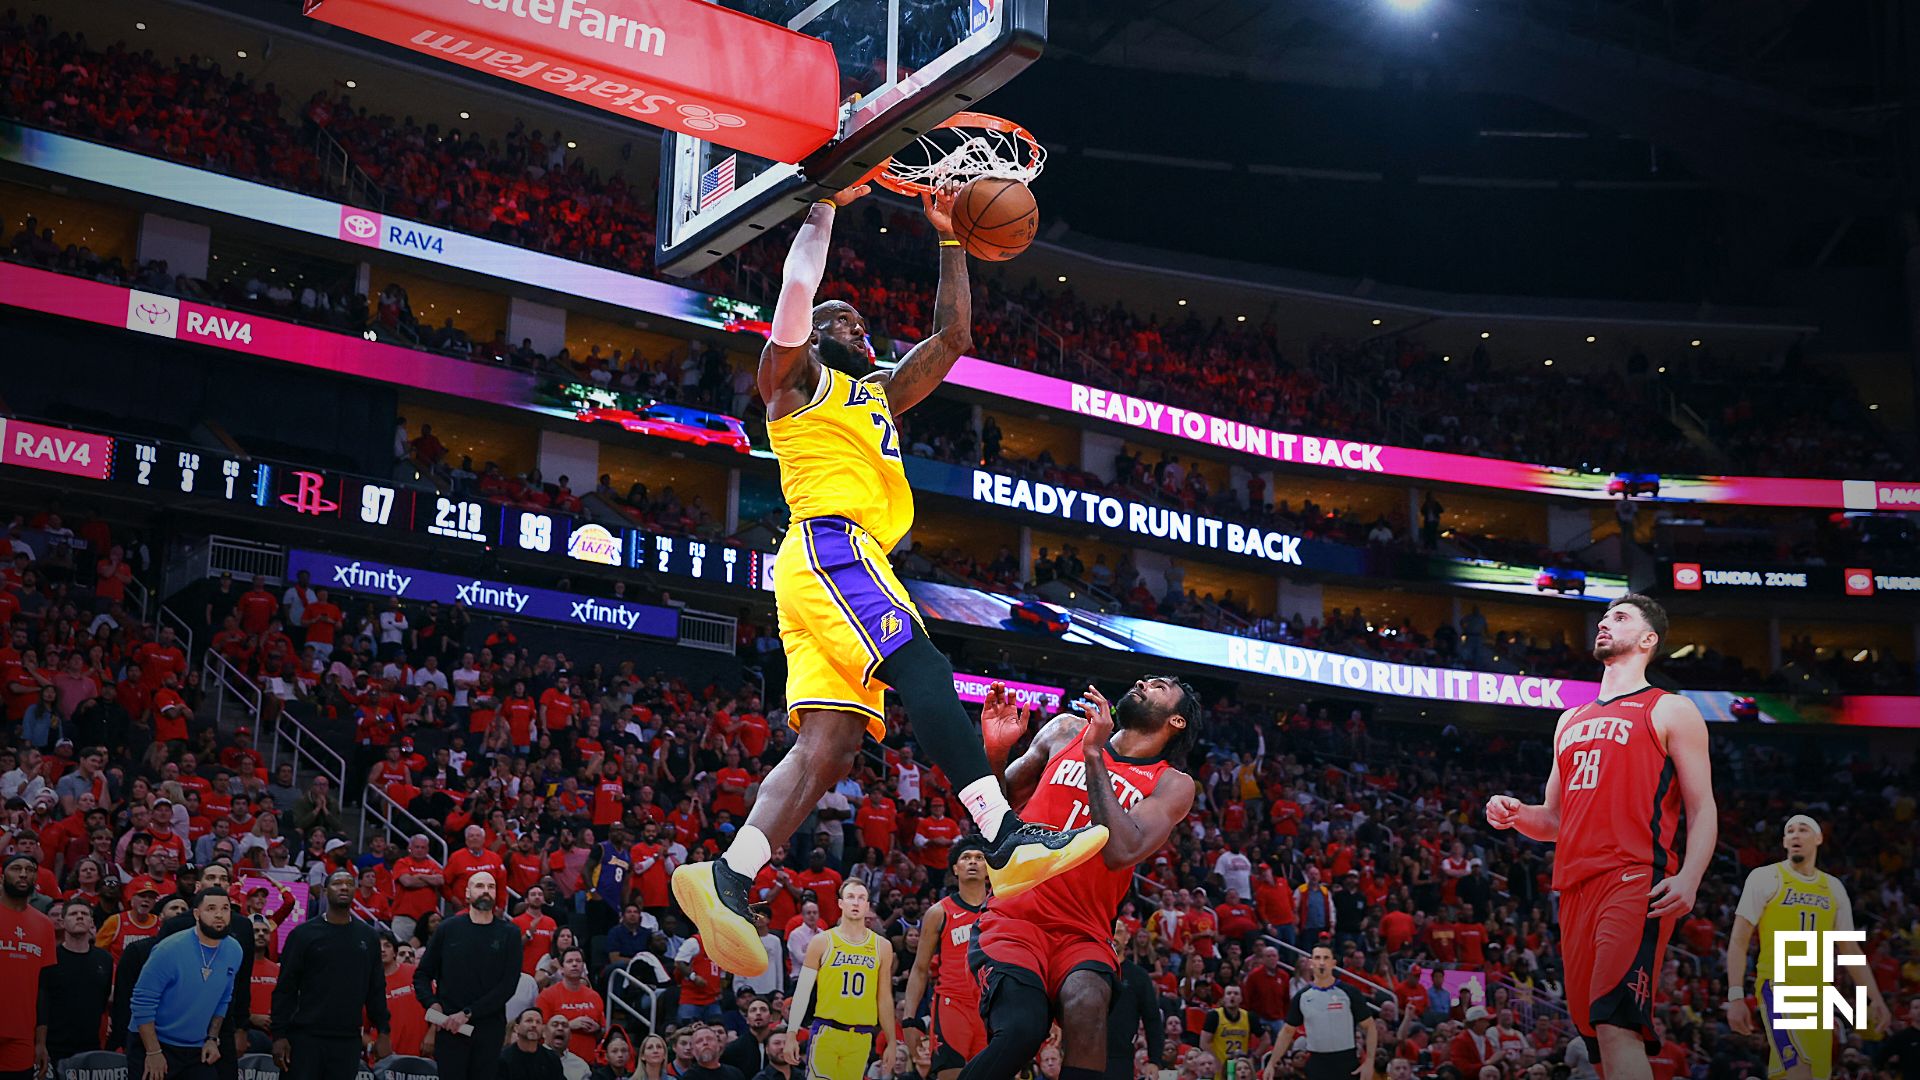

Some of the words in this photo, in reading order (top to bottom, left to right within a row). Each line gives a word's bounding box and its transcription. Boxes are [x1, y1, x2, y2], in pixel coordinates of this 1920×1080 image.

[467, 0, 666, 56] eFarm
[390, 226, 444, 254] RAV4
[187, 311, 252, 344] RAV4
[1071, 384, 1164, 430] READY
[1167, 407, 1206, 440] TO
[1210, 418, 1266, 455] RUN
[1271, 432, 1298, 461] IT
[1302, 436, 1384, 472] BACK
[15, 432, 90, 466] RAV4
[138, 461, 151, 485] 2
[181, 469, 194, 492] 3
[225, 476, 234, 499] 1
[361, 484, 395, 525] 97
[435, 498, 482, 532] 2:13
[972, 470, 1077, 518] READY
[1081, 493, 1124, 527] TO
[1129, 503, 1191, 543] RUN
[1197, 517, 1223, 548] IT
[1227, 523, 1303, 565] BACK
[519, 512, 552, 552] 93
[333, 561, 412, 595] xfinity
[659, 551, 669, 572] 2
[726, 563, 733, 583] 1
[1703, 570, 1763, 586] TUNDRA
[1765, 572, 1807, 587] ZONE
[455, 581, 530, 613] xfinity
[570, 599, 640, 630] xfinity
[954, 679, 993, 696] ENERG
[1228, 637, 1328, 681] READY
[1328, 654, 1367, 688] TO
[1372, 661, 1437, 698] RUN
[1443, 670, 1473, 700] IT
[1478, 673, 1565, 709] BACK
[1049, 759, 1146, 814] ROCETS
[1568, 749, 1602, 791] 28
[615, 867, 623, 882] 8
[1781, 887, 1830, 910] LAKERS
[1800, 911, 1816, 931] 11
[831, 951, 876, 970] LAKERS
[841, 971, 865, 997] 10
